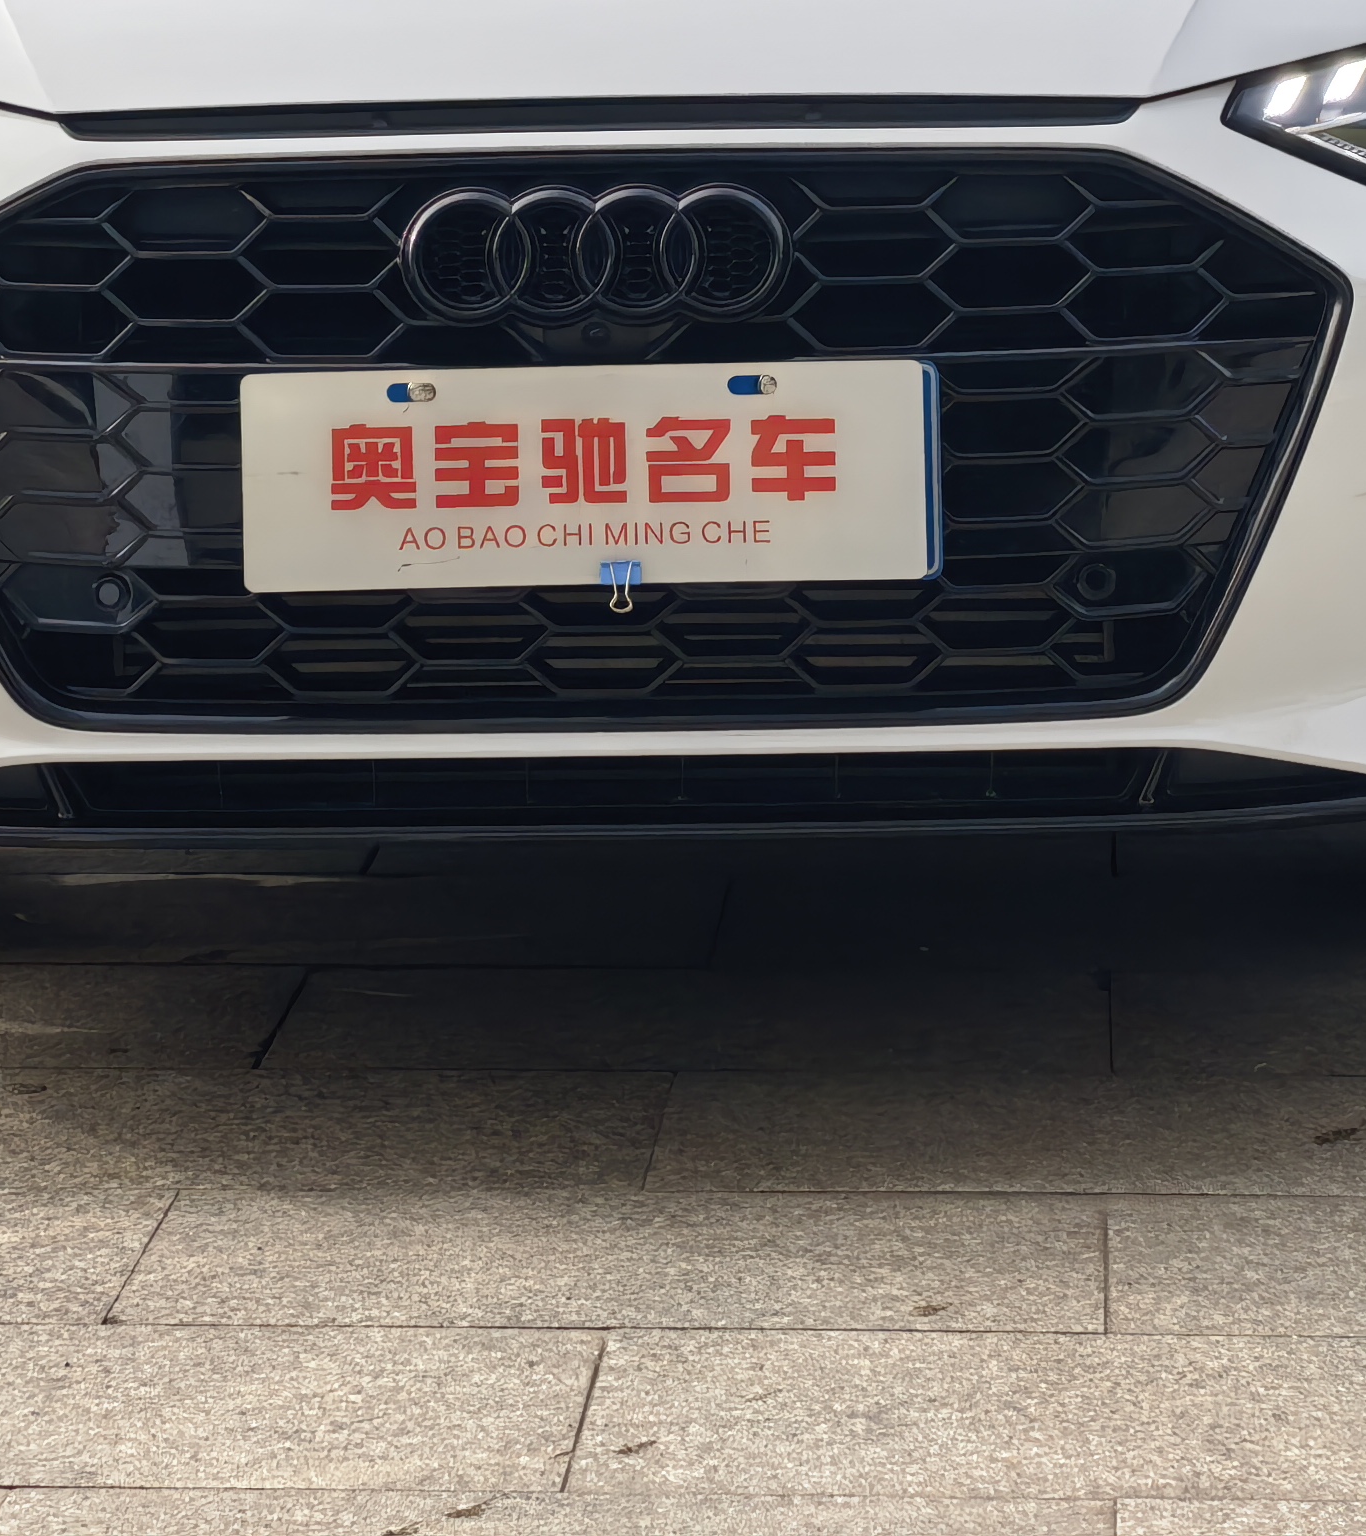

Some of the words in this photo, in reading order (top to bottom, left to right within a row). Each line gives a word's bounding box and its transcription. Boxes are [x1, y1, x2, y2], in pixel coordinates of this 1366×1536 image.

[330, 415, 837, 511] 奥宝驰名车
[398, 526, 447, 551] AO
[456, 524, 528, 550] BAO
[535, 522, 594, 548] CHI
[603, 520, 693, 547] MING
[701, 519, 772, 545] CHE
